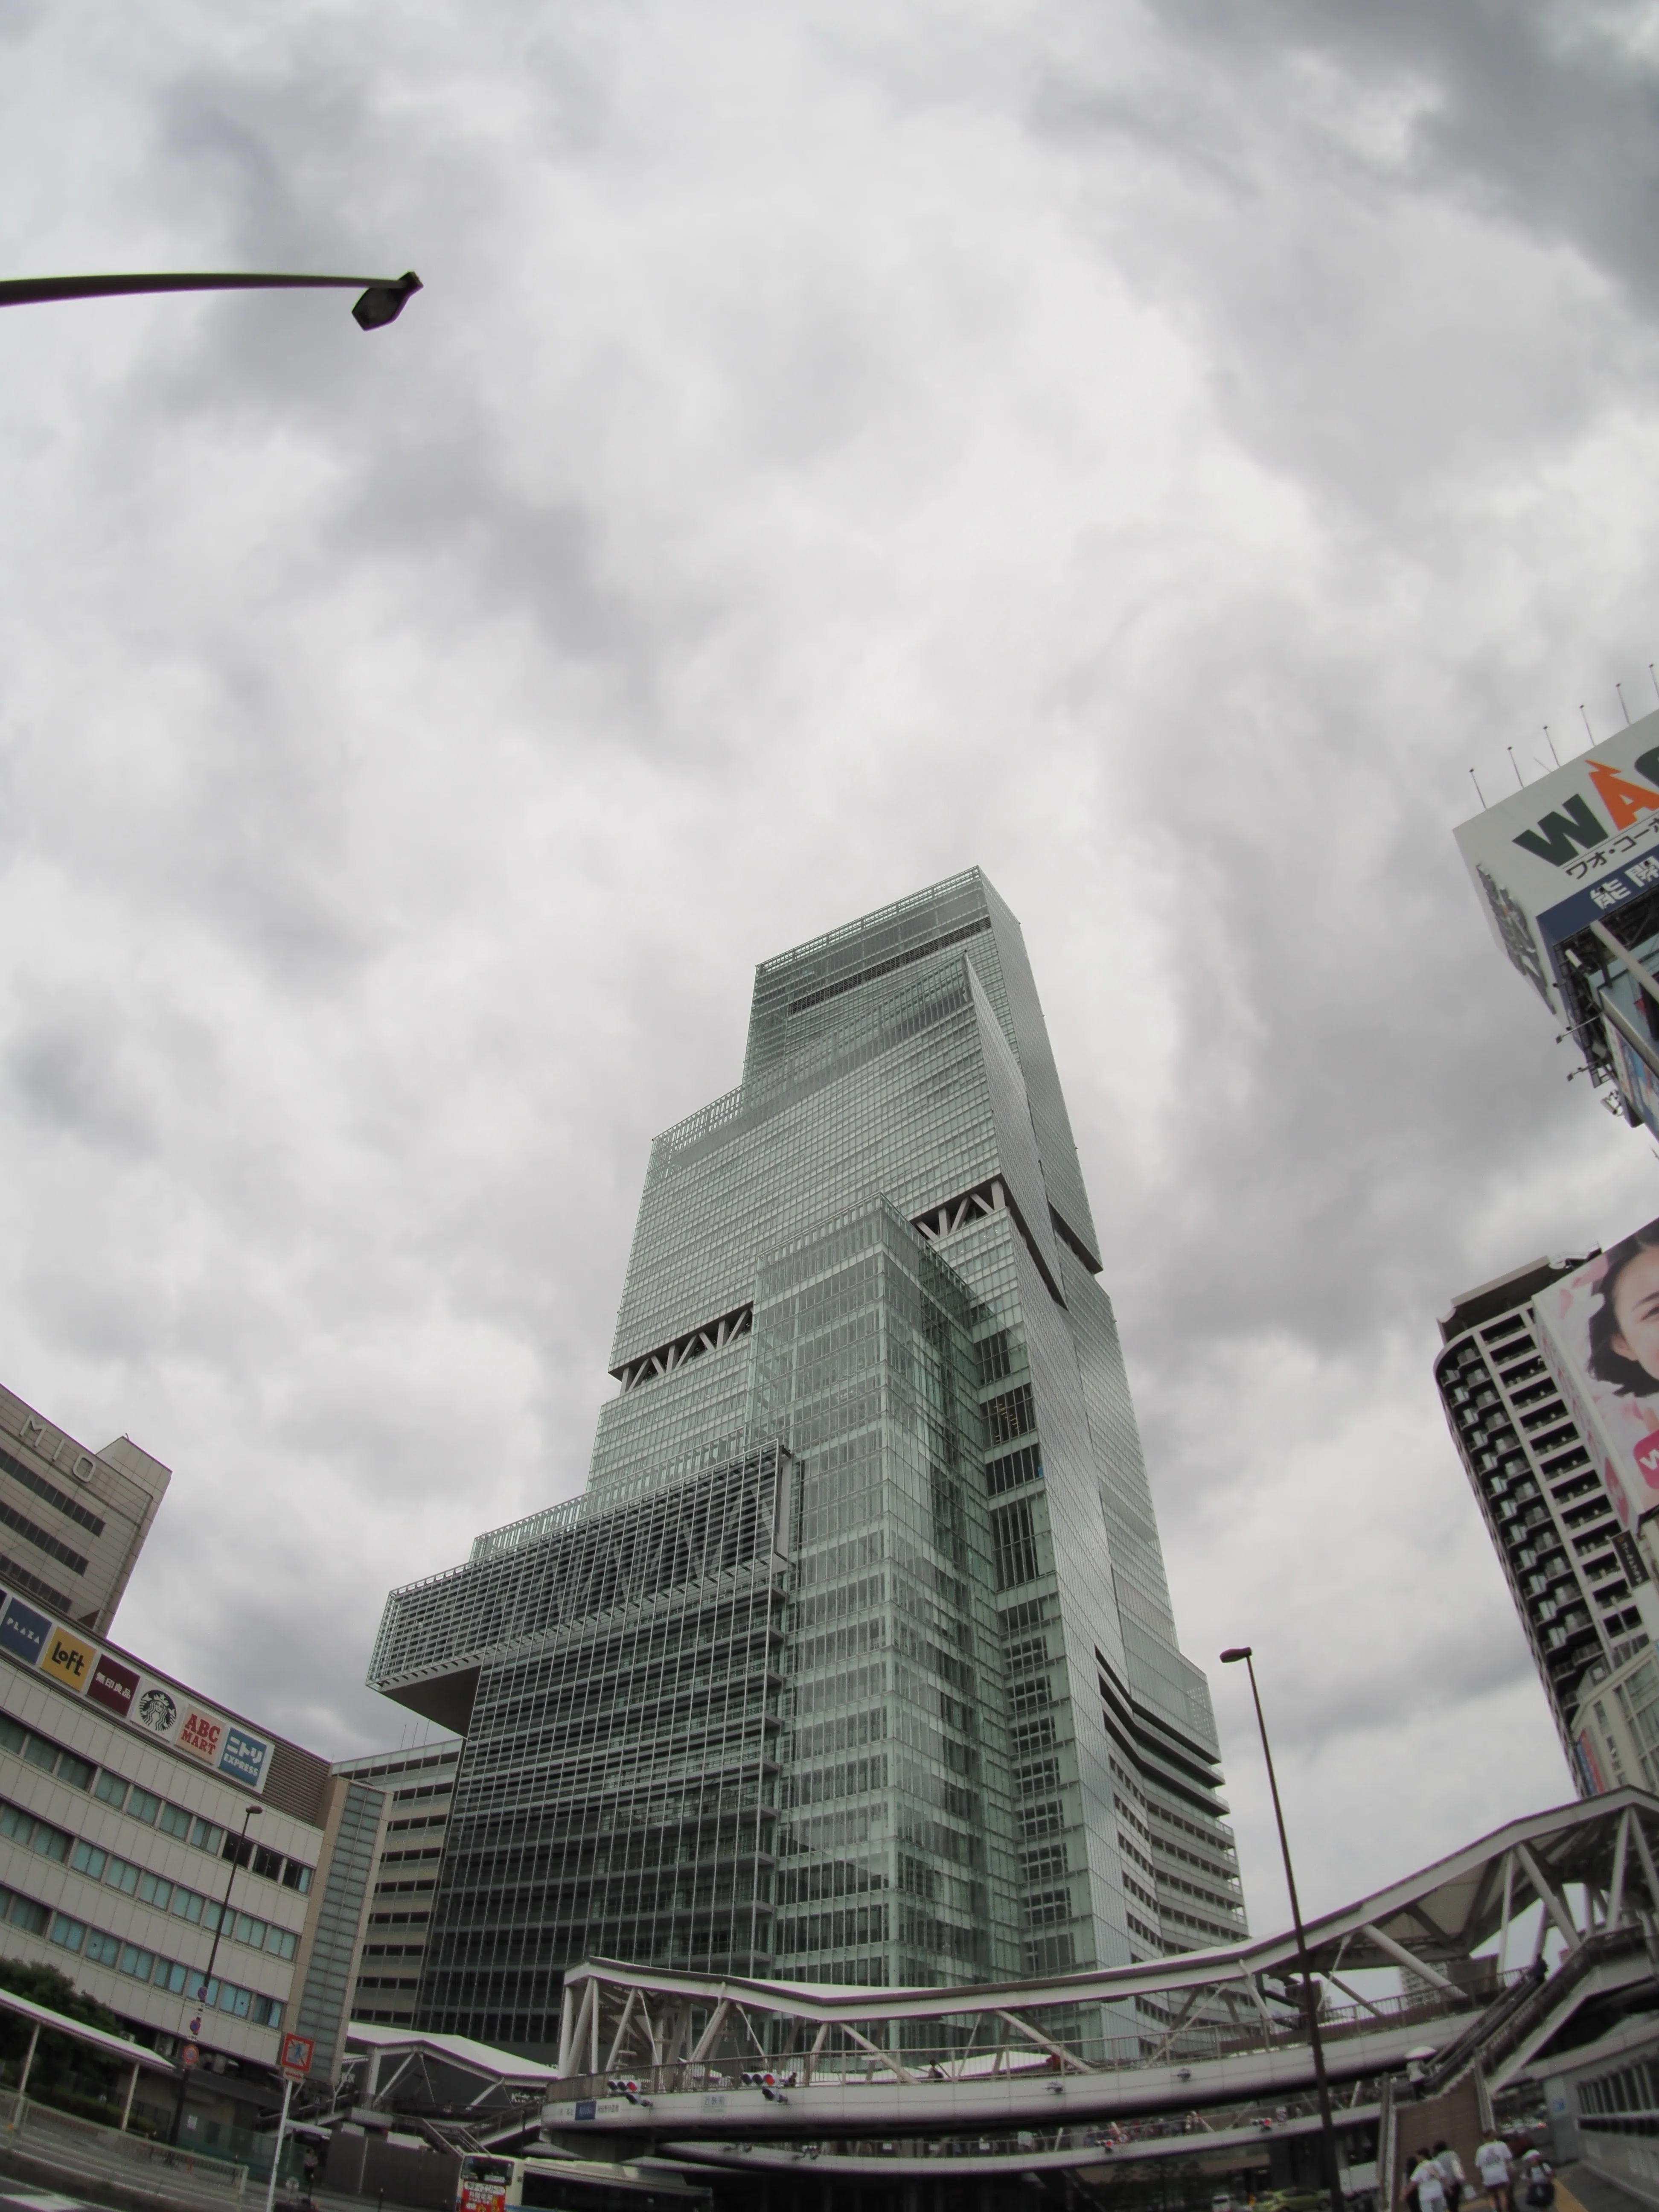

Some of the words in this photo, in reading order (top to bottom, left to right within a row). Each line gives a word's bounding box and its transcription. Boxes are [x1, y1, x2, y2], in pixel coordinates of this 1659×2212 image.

[19, 1415, 97, 1483] MIO
[7, 1617, 40, 1644] PLAZA
[96, 1672, 131, 1699] 無印良品
[181, 1729, 216, 1755] MART
[185, 1714, 221, 1743] ABC
[227, 1736, 263, 1764] ニトリ
[223, 1752, 259, 1776] EXPRESS
